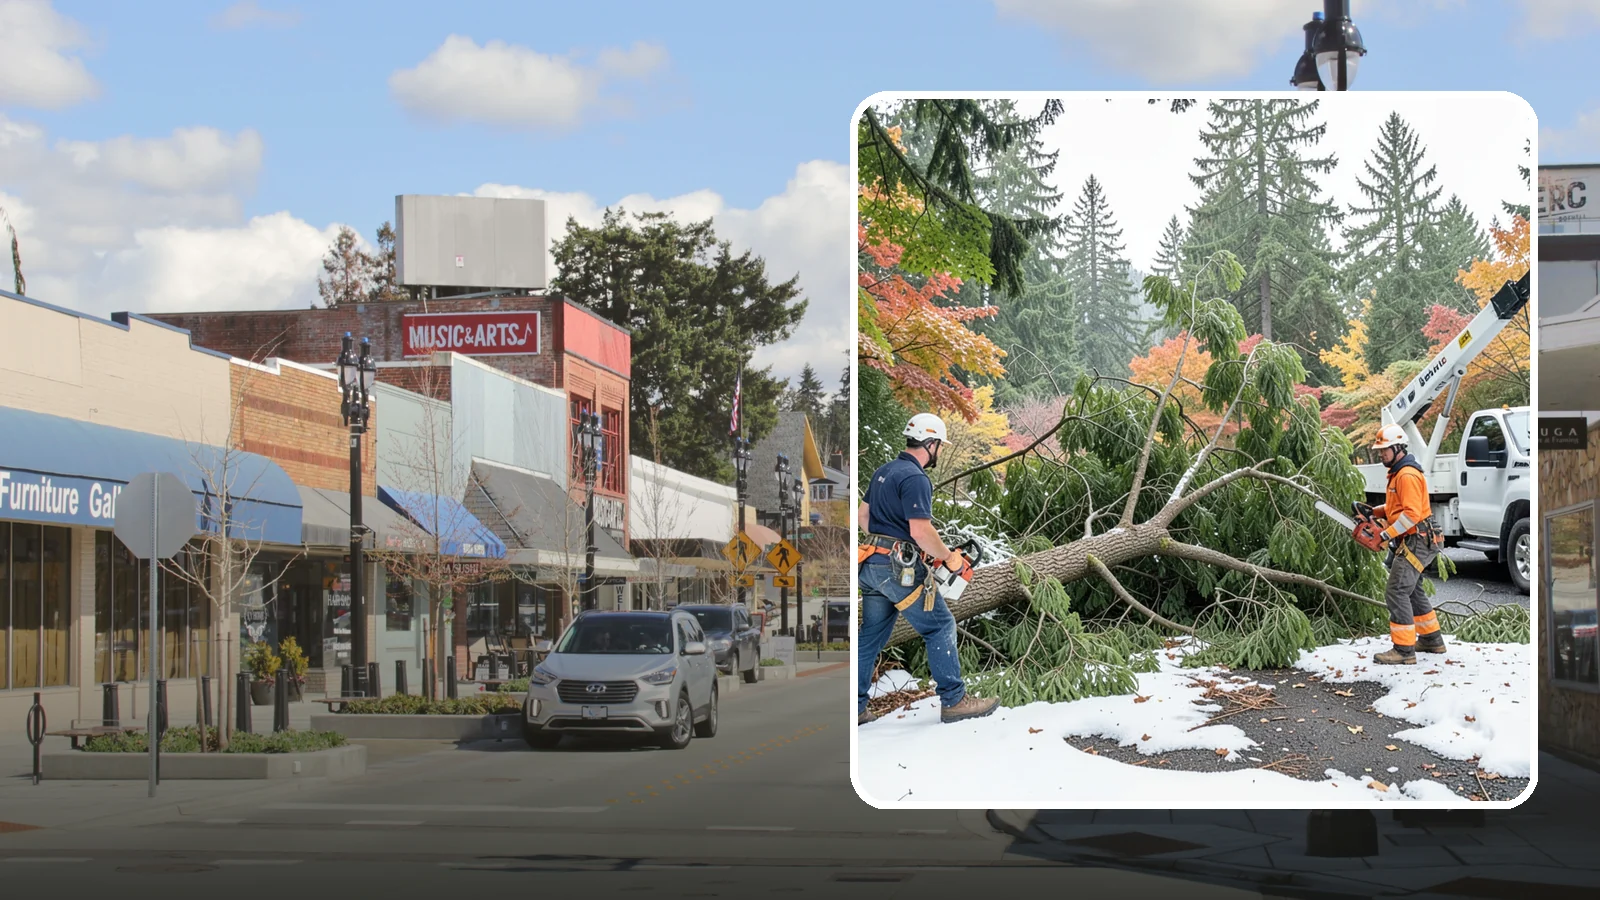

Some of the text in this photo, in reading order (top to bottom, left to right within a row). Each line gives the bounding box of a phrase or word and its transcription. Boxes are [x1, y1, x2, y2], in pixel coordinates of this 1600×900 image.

[0, 471, 122, 519] Furniture Gal
[453, 563, 479, 574] SUSHI
